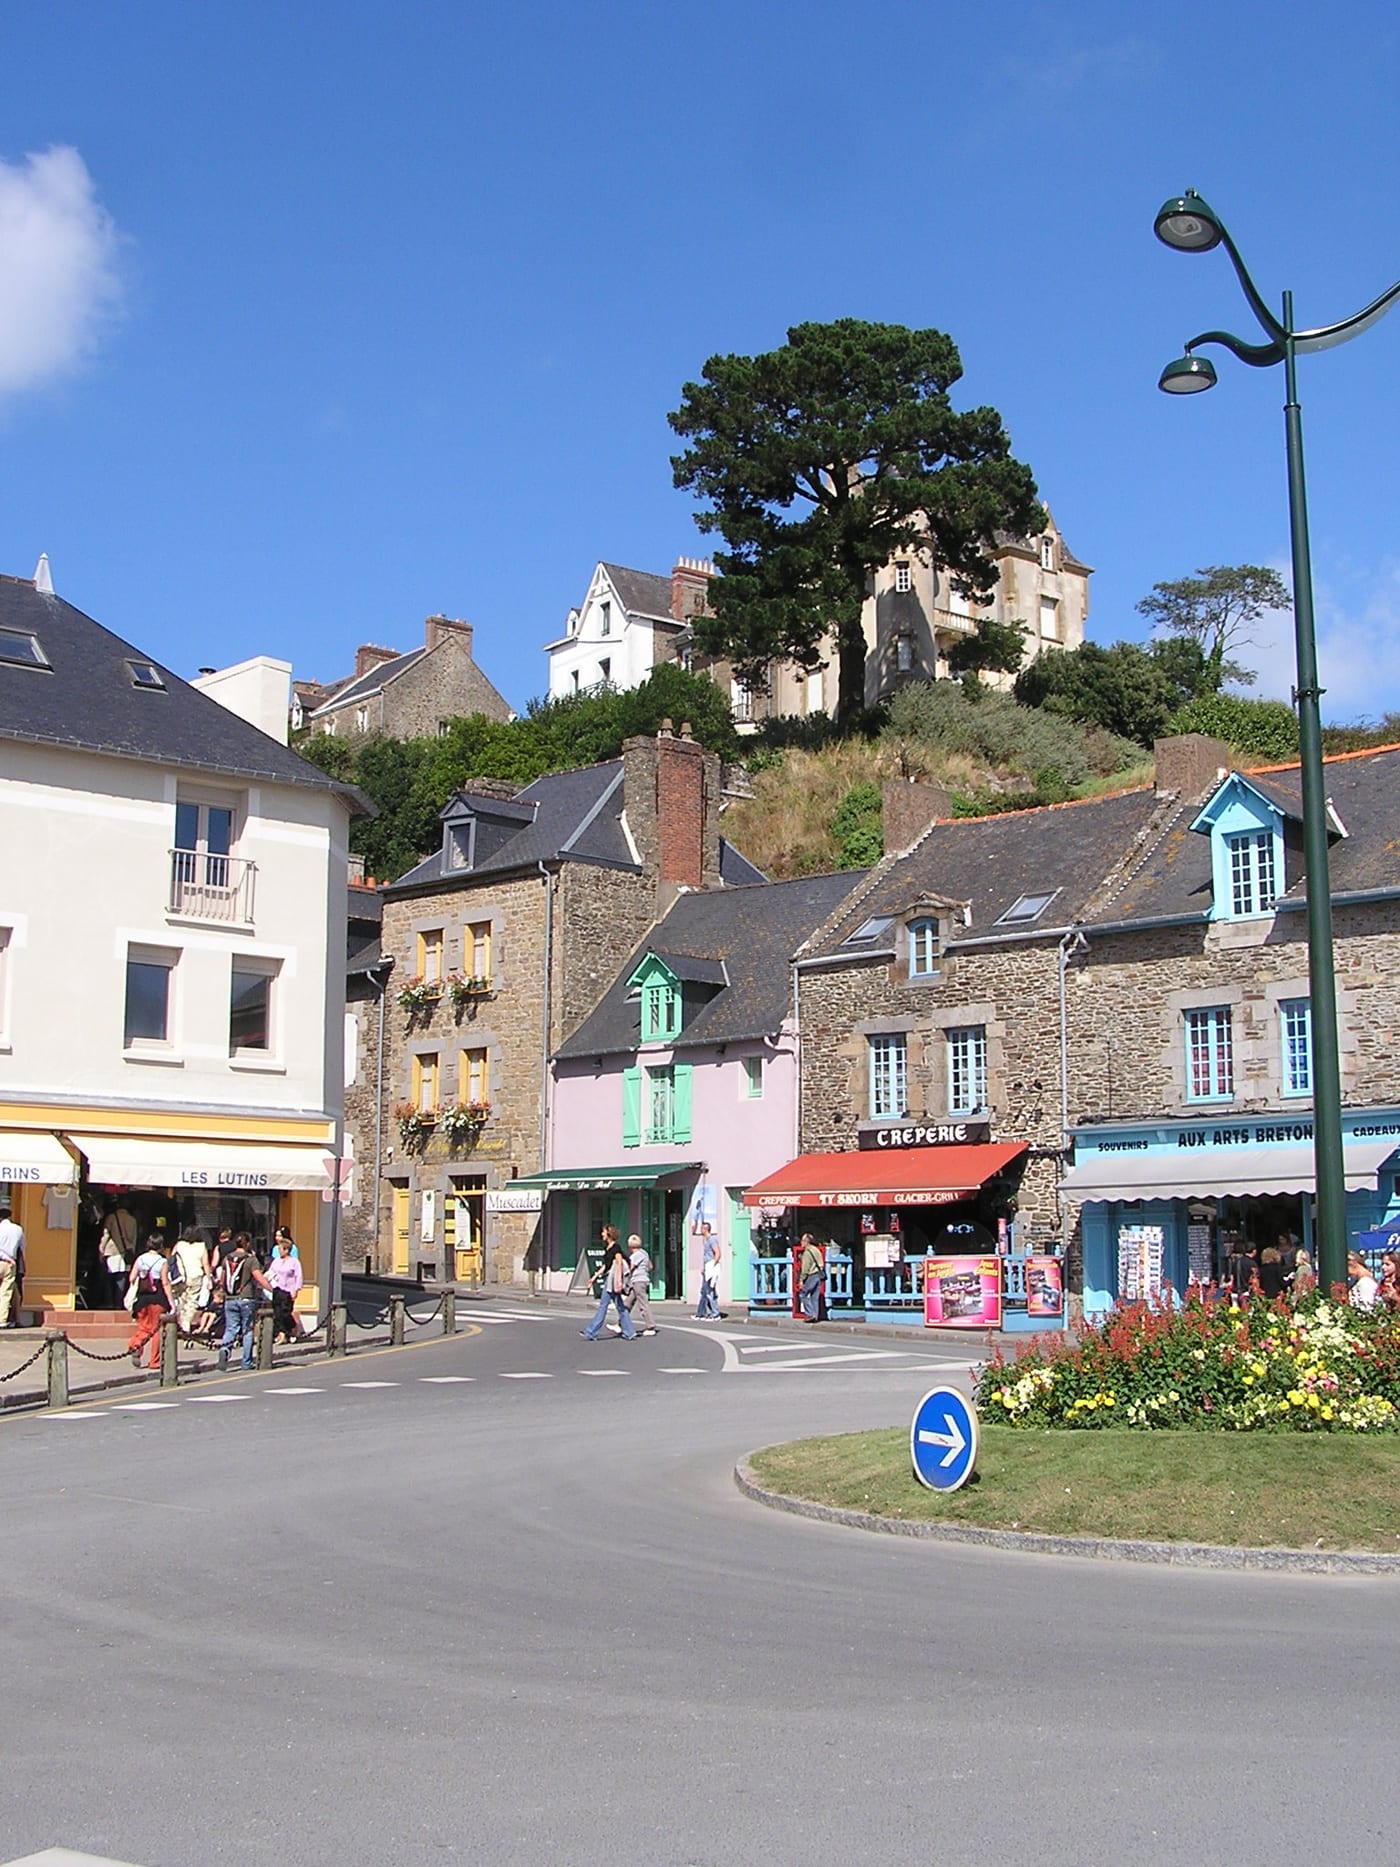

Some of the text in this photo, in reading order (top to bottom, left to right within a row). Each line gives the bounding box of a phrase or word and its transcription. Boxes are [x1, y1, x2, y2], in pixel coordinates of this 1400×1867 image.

[877, 1124, 968, 1146] CREPERIE
[1178, 1123, 1313, 1147] AUX ARTS BRETON
[1098, 1140, 1148, 1152] SOUVENIRS
[2, 1167, 40, 1180] RINS
[182, 1171, 268, 1186] LES LUTINS
[487, 1190, 540, 1209] Muscadet
[819, 1194, 835, 1205] TY
